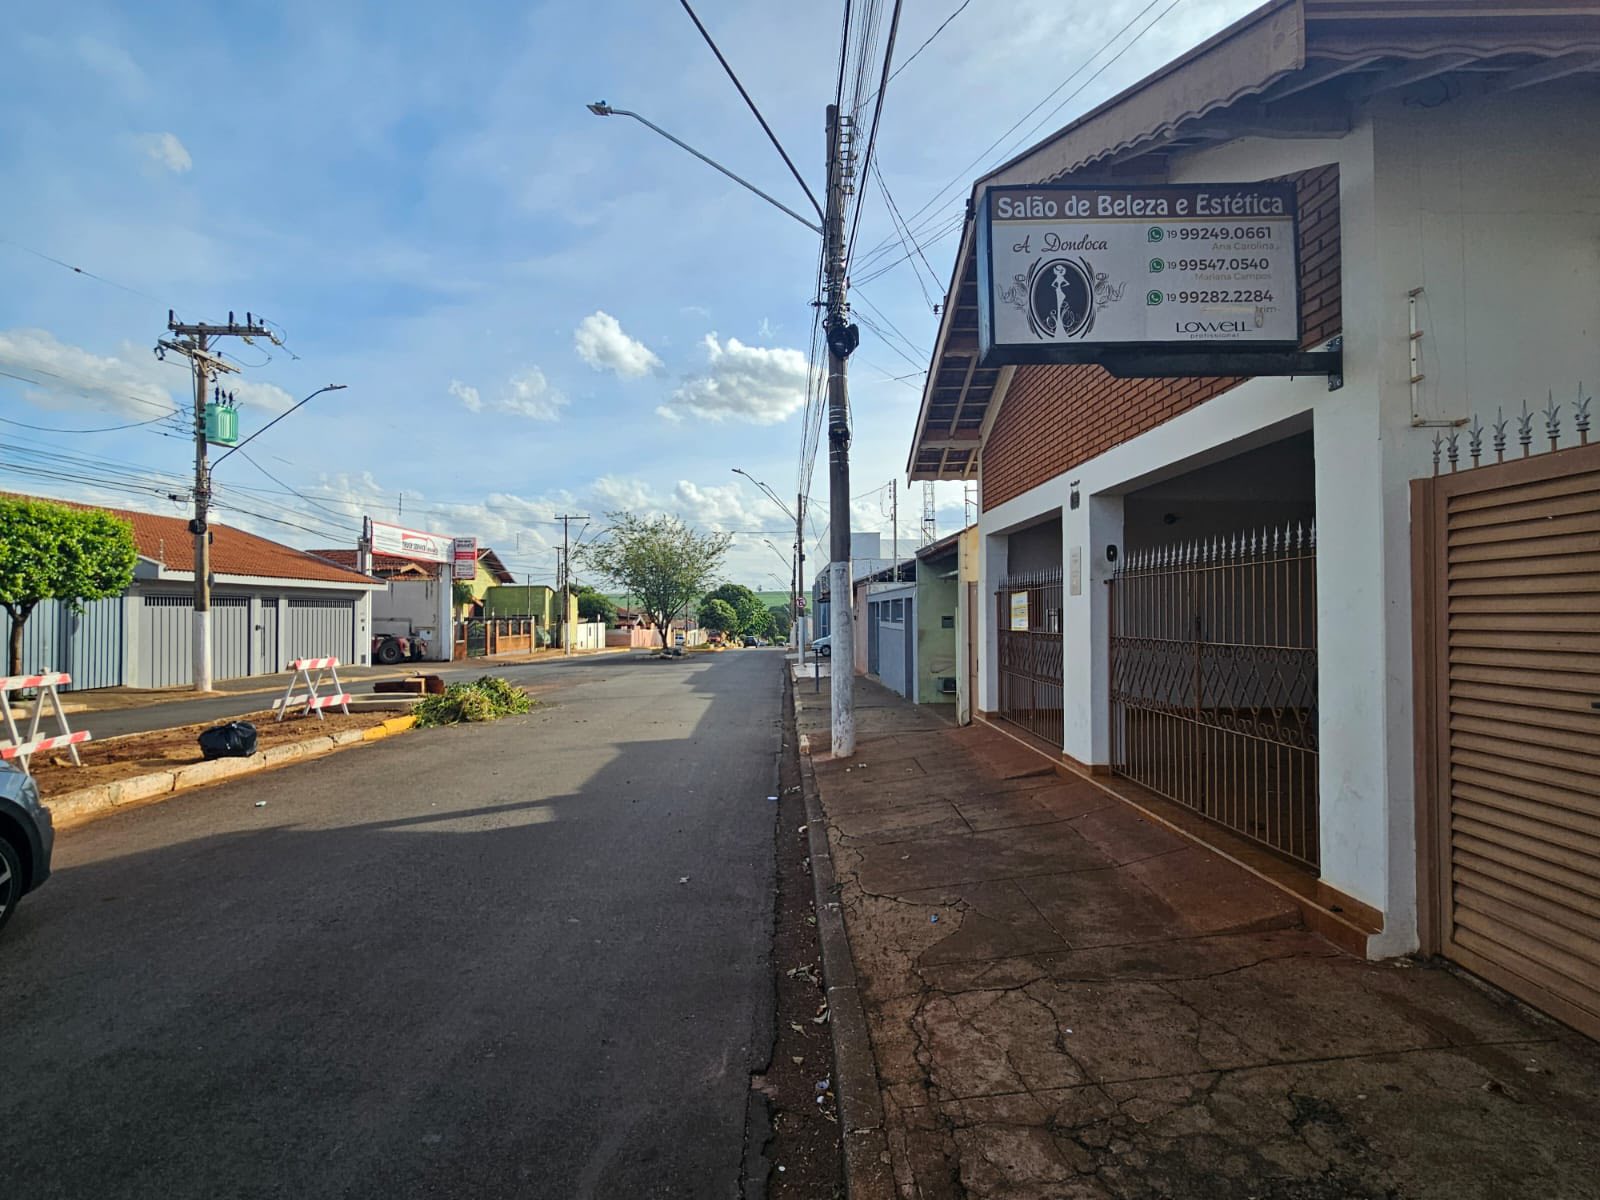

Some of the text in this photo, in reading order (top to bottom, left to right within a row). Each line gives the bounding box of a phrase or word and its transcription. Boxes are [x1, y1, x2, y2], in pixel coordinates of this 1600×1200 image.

[998, 192, 1283, 218] Salão de Beleza e Estética
[1167, 226, 1272, 240] 19 99249.0661
[1012, 232, 1108, 254] A Dondoca
[1167, 258, 1269, 271] 19 99547.0540
[1166, 289, 1274, 304] 19 99282.2284
